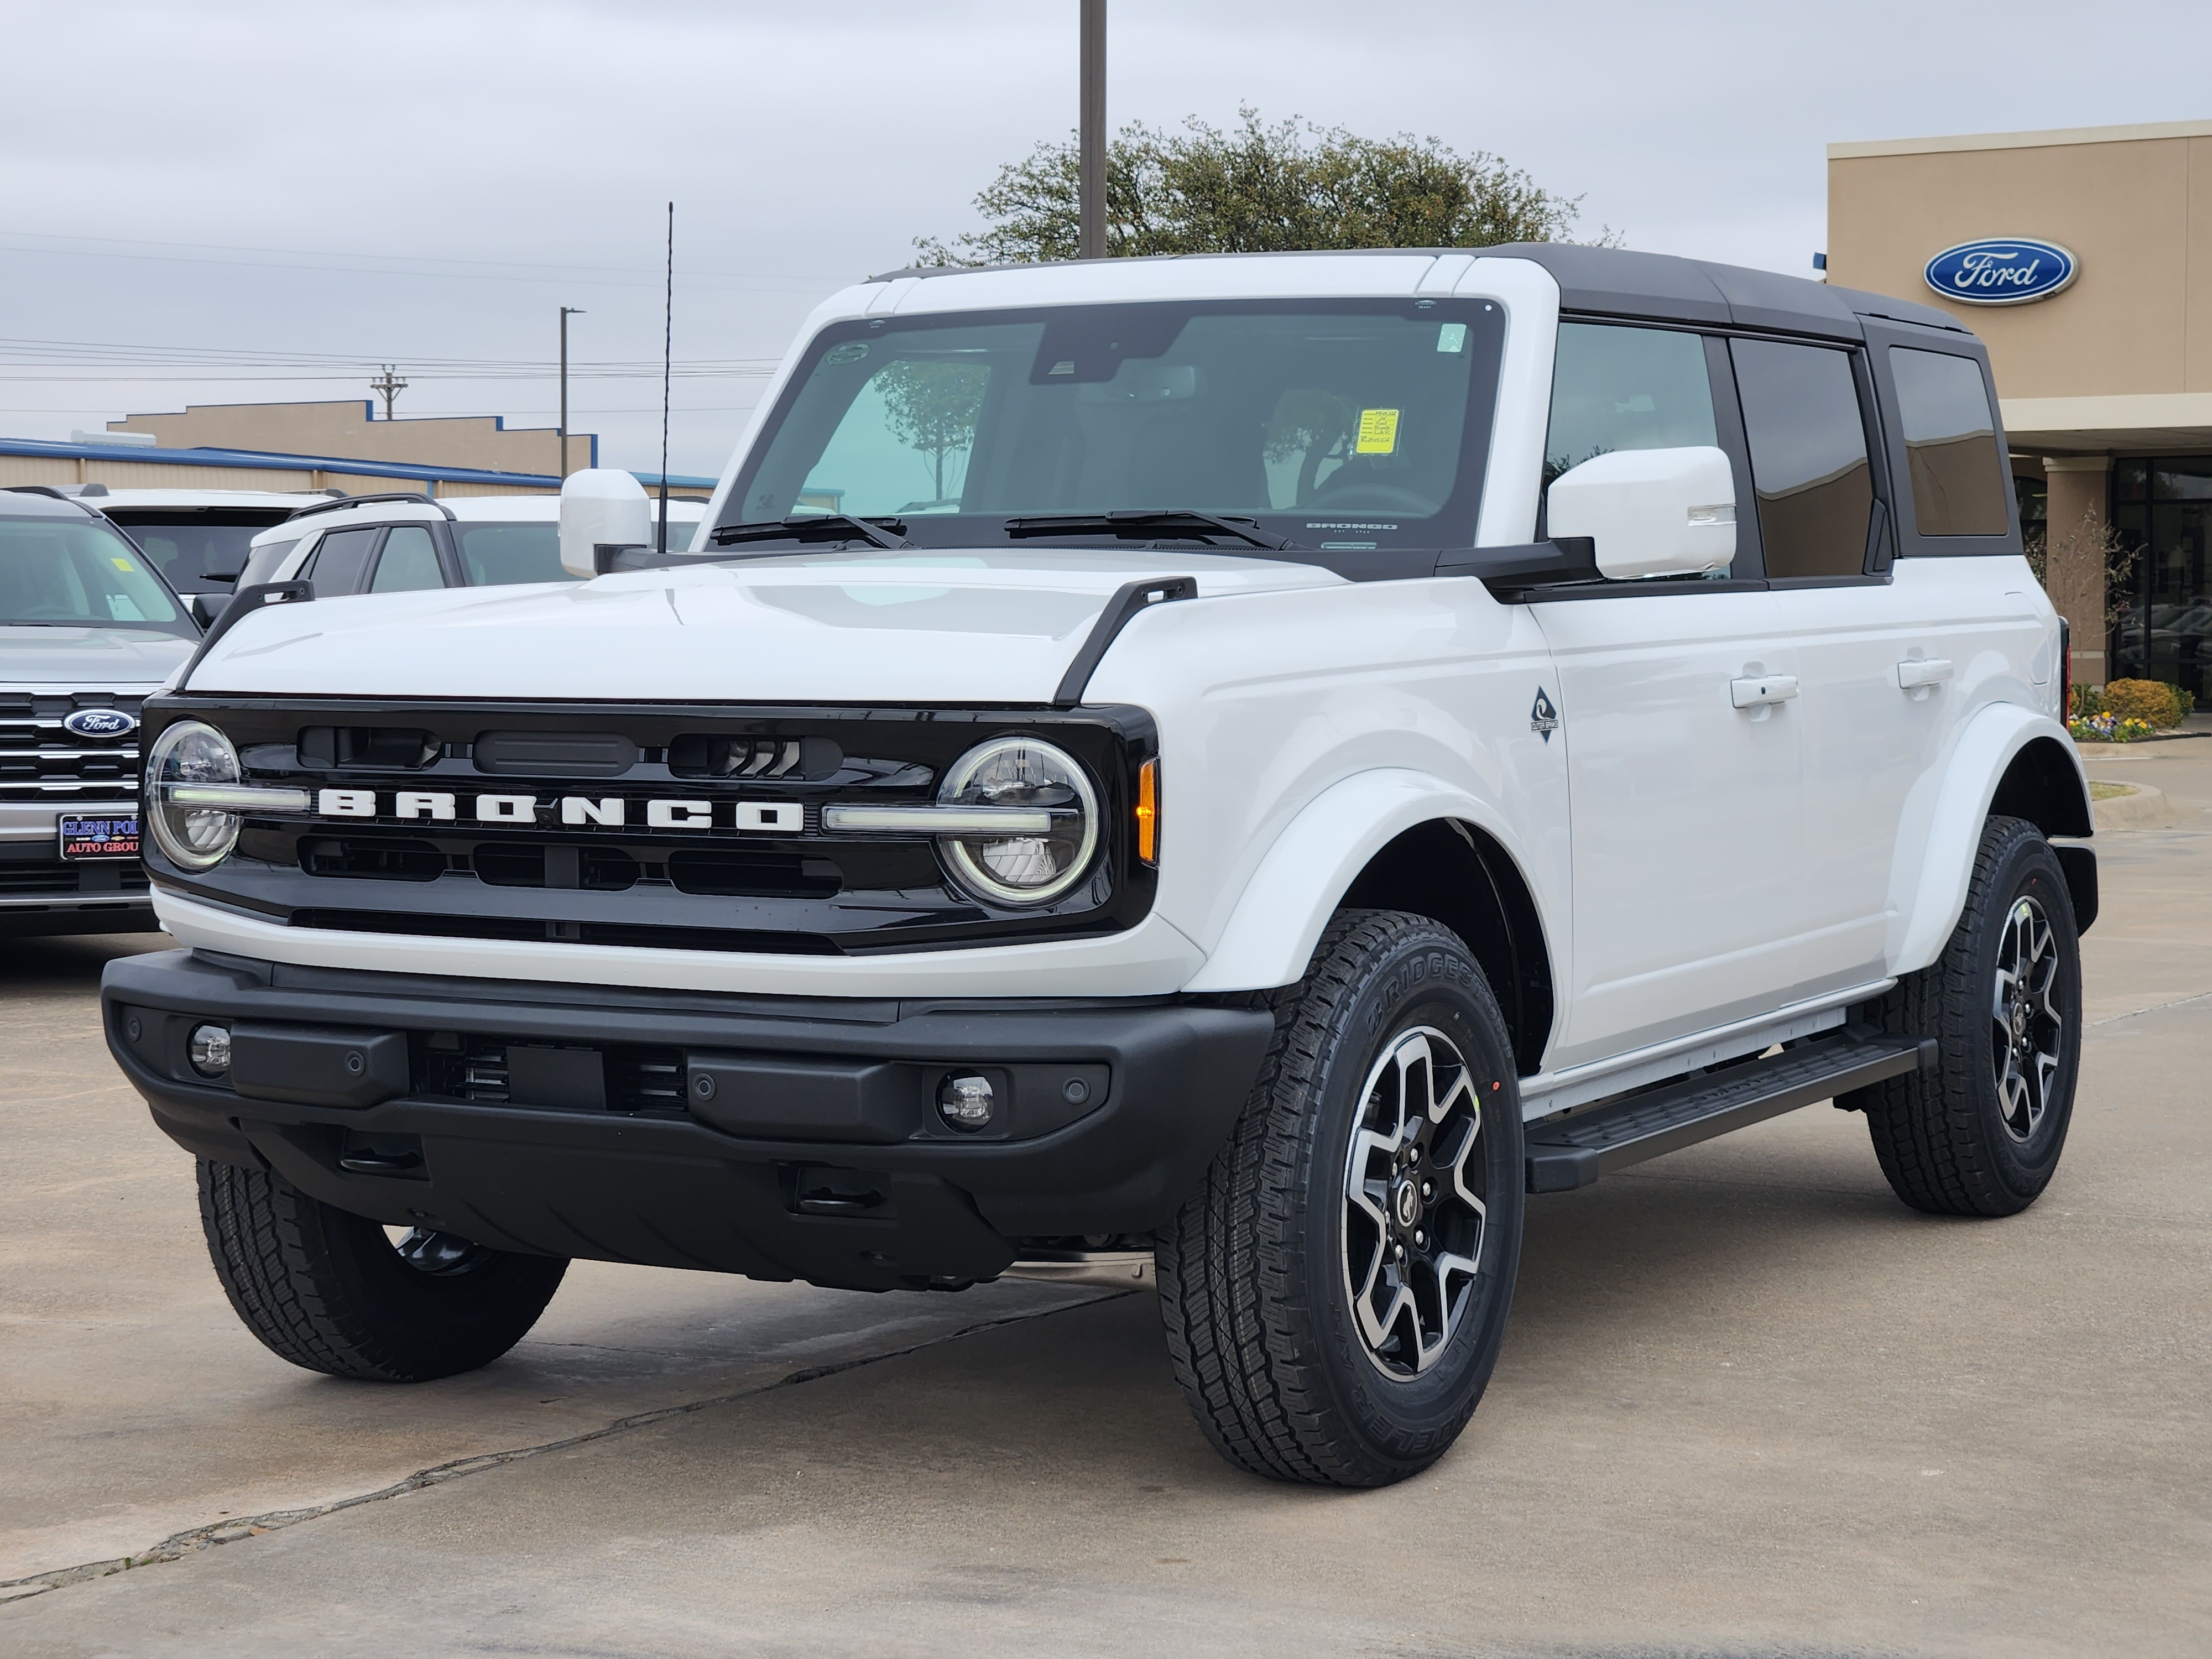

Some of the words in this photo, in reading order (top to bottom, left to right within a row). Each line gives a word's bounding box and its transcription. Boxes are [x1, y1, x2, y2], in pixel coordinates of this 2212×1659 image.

[1954, 252, 2041, 288] Ford
[82, 714, 121, 730] Ford
[319, 789, 804, 831] BRONCO
[62, 821, 111, 836] GLENN
[112, 820, 138, 834] POL
[66, 842, 102, 853] AUTO
[103, 842, 139, 852] GROU
